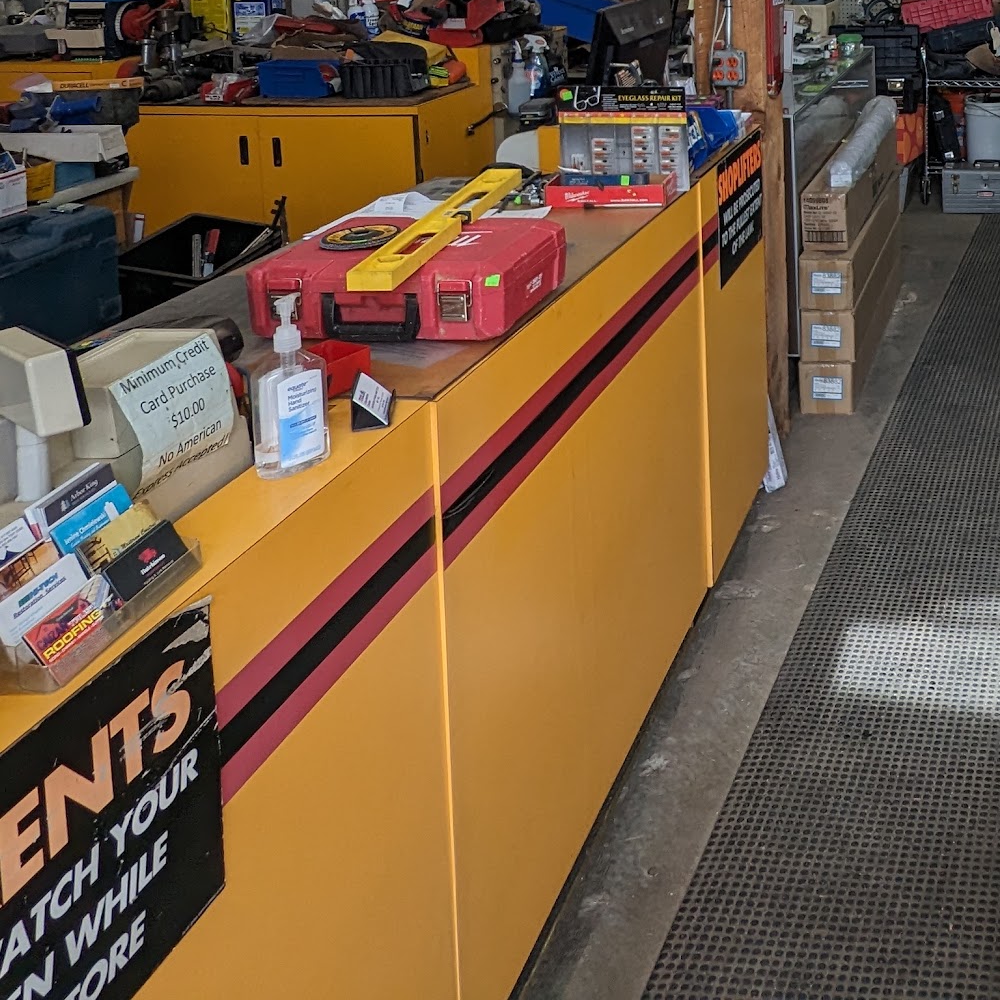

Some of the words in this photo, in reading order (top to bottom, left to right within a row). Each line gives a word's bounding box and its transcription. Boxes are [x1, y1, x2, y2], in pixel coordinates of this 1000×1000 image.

[718, 139, 762, 206] SHOPLIFTERS
[119, 357, 178, 395] Minimum
[175, 339, 210, 365] Credit
[140, 391, 168, 415] Card
[169, 364, 217, 400] Purchase
[171, 397, 206, 428] $10.00
[158, 448, 174, 468] No
[177, 418, 222, 456] American
[133, 469, 174, 500] Express
[42, 609, 102, 660] ROOFING
[0, 842, 100, 978] ATCH
[110, 747, 199, 858] YOUR
[65, 830, 169, 966] WHILE
